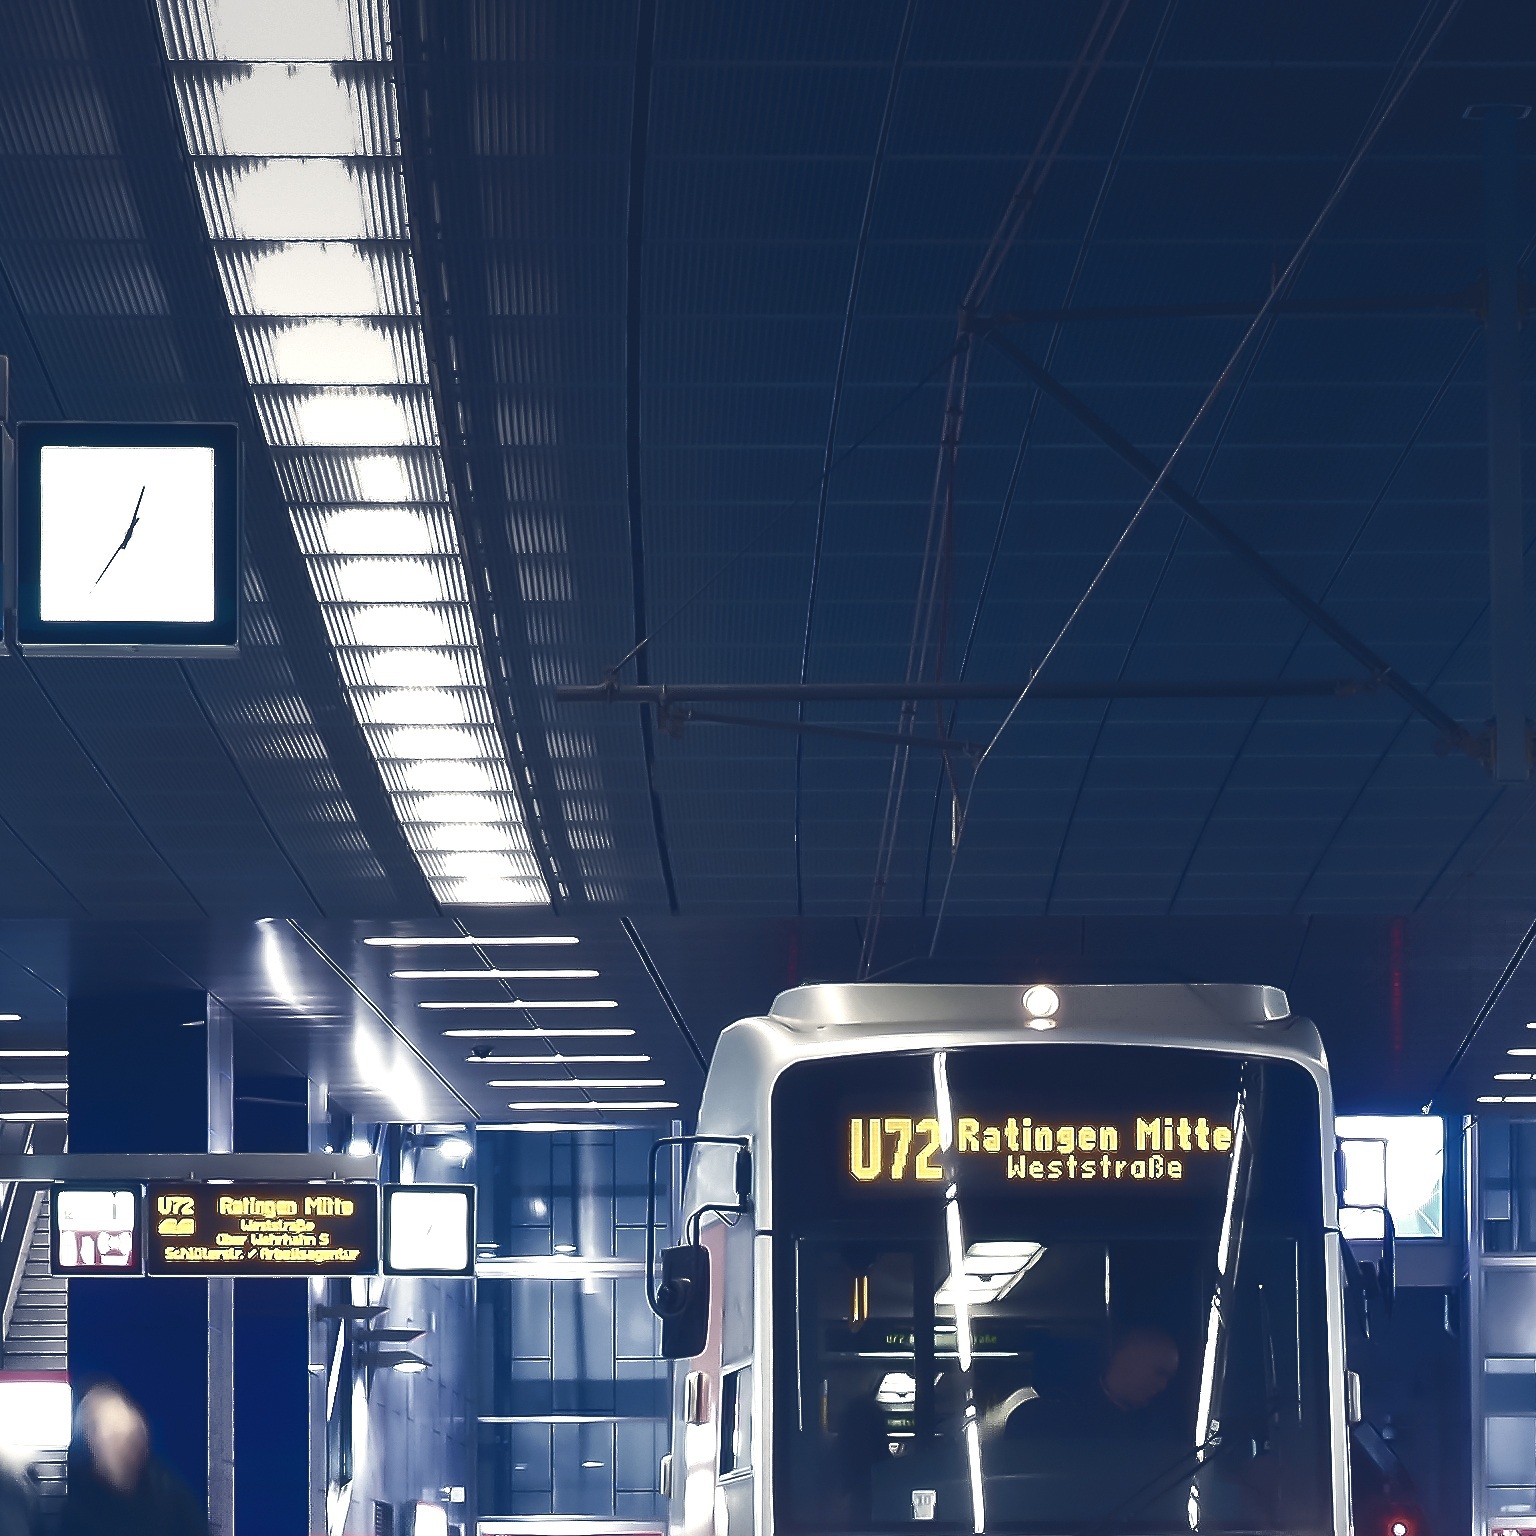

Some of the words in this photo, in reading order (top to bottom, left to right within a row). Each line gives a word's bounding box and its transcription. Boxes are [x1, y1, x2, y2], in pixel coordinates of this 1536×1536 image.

[849, 1117, 945, 1182] U72
[957, 1117, 1120, 1155] Ratingen
[1135, 1116, 1234, 1153] Mitte
[1005, 1154, 1184, 1180] Weststraße
[157, 1196, 196, 1216] U72
